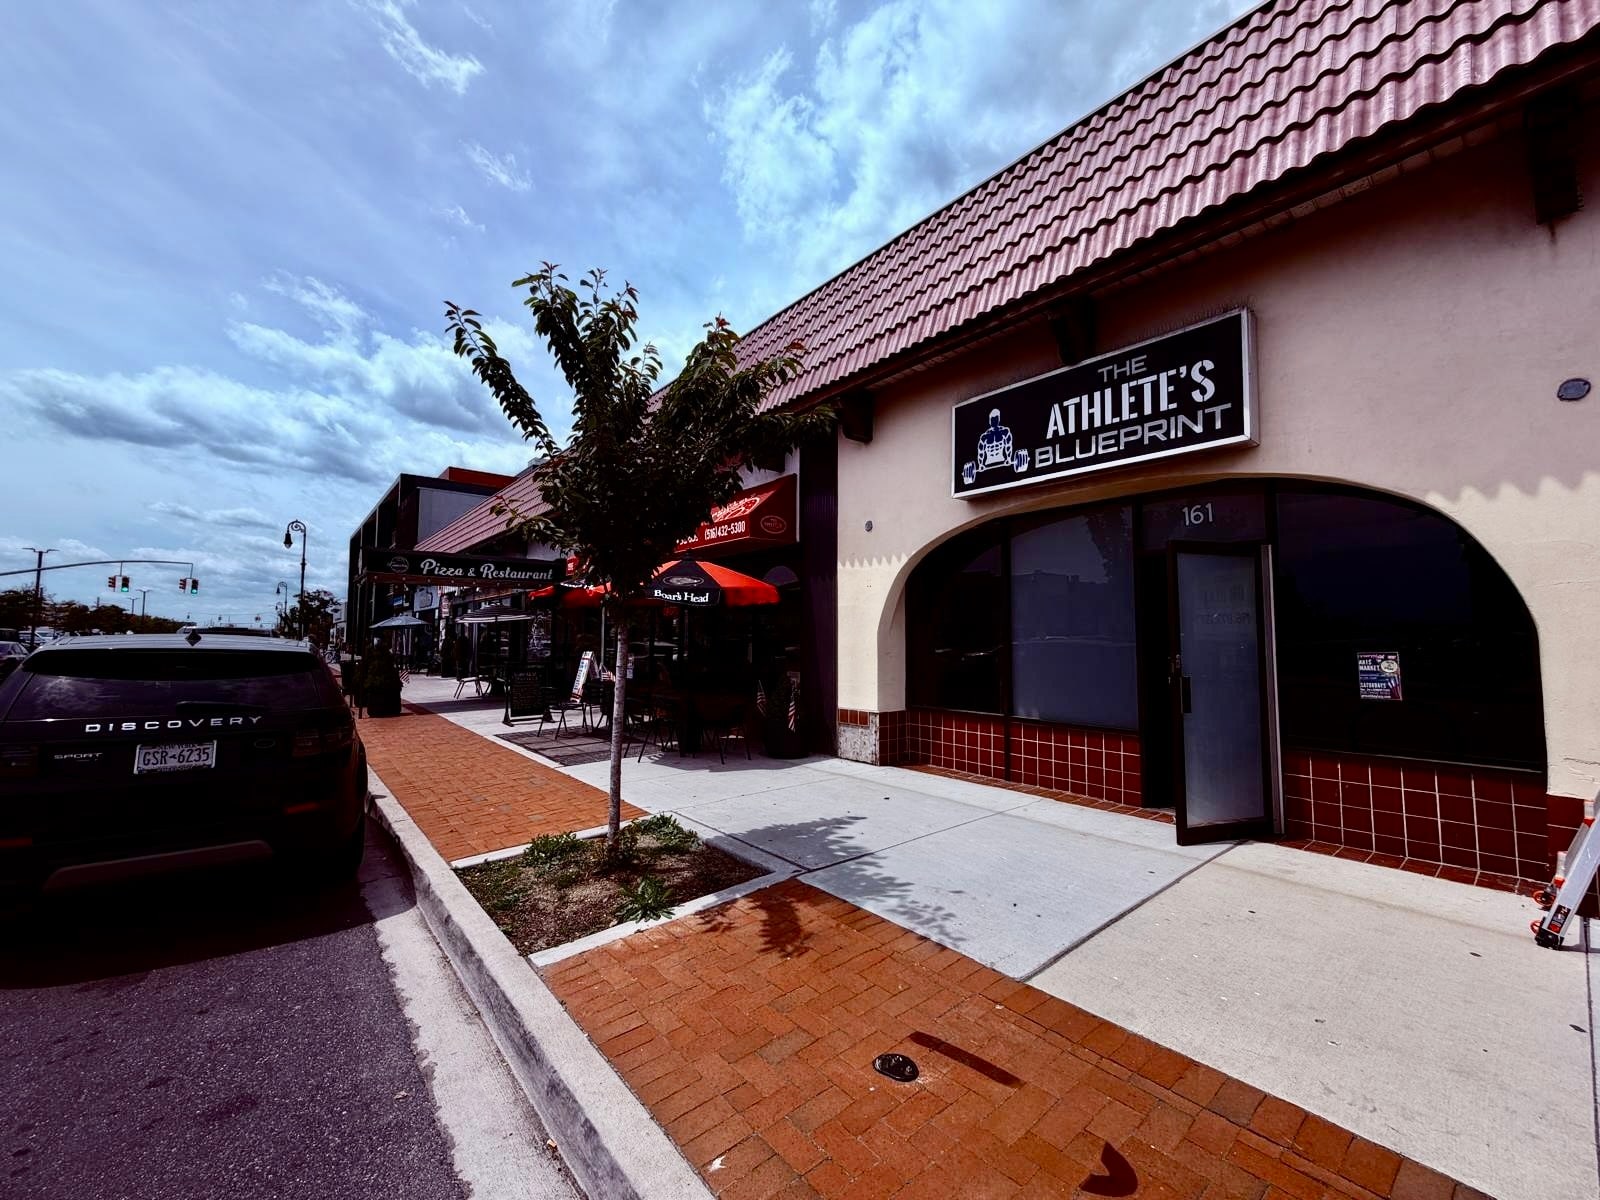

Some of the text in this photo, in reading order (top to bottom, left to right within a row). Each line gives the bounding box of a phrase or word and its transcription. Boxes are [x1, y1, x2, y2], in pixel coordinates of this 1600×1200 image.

[1097, 354, 1148, 382] THE
[1045, 358, 1217, 440] ATHLETE'S
[1034, 403, 1232, 468] BLUEPRINT
[1182, 502, 1213, 526] 161
[420, 558, 464, 576] Pizza
[467, 567, 477, 577] &
[479, 563, 553, 580] Restaurant
[683, 591, 709, 603] Head
[84, 716, 262, 733] DISCOVERY
[53, 752, 104, 760] SPORT
